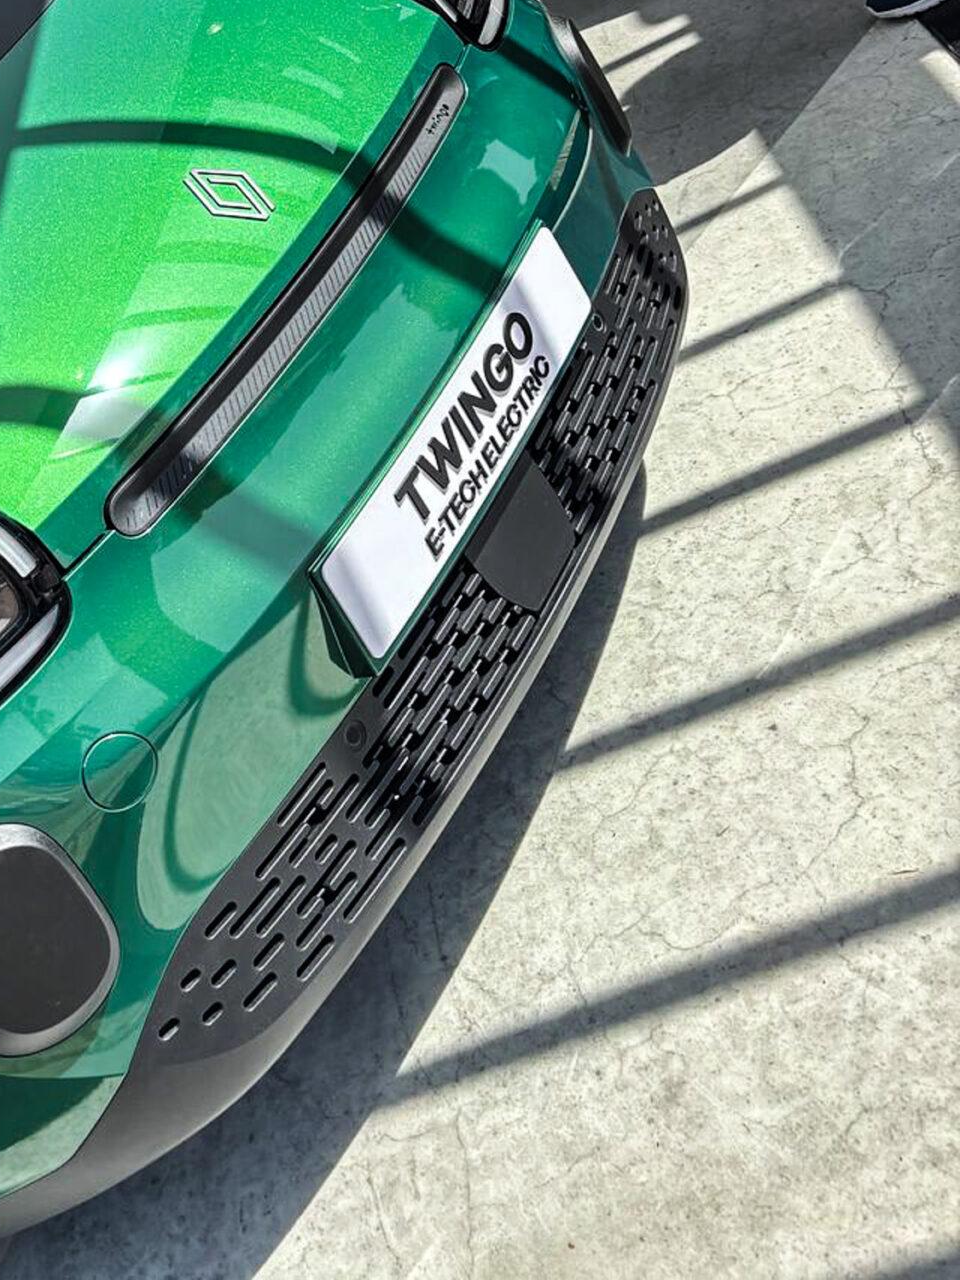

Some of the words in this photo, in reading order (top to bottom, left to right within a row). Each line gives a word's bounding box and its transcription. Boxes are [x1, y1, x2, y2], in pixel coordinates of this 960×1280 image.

[394, 312, 533, 523] TWINGO
[424, 459, 489, 559] E-TECH
[480, 355, 550, 471] ELECTRIC
